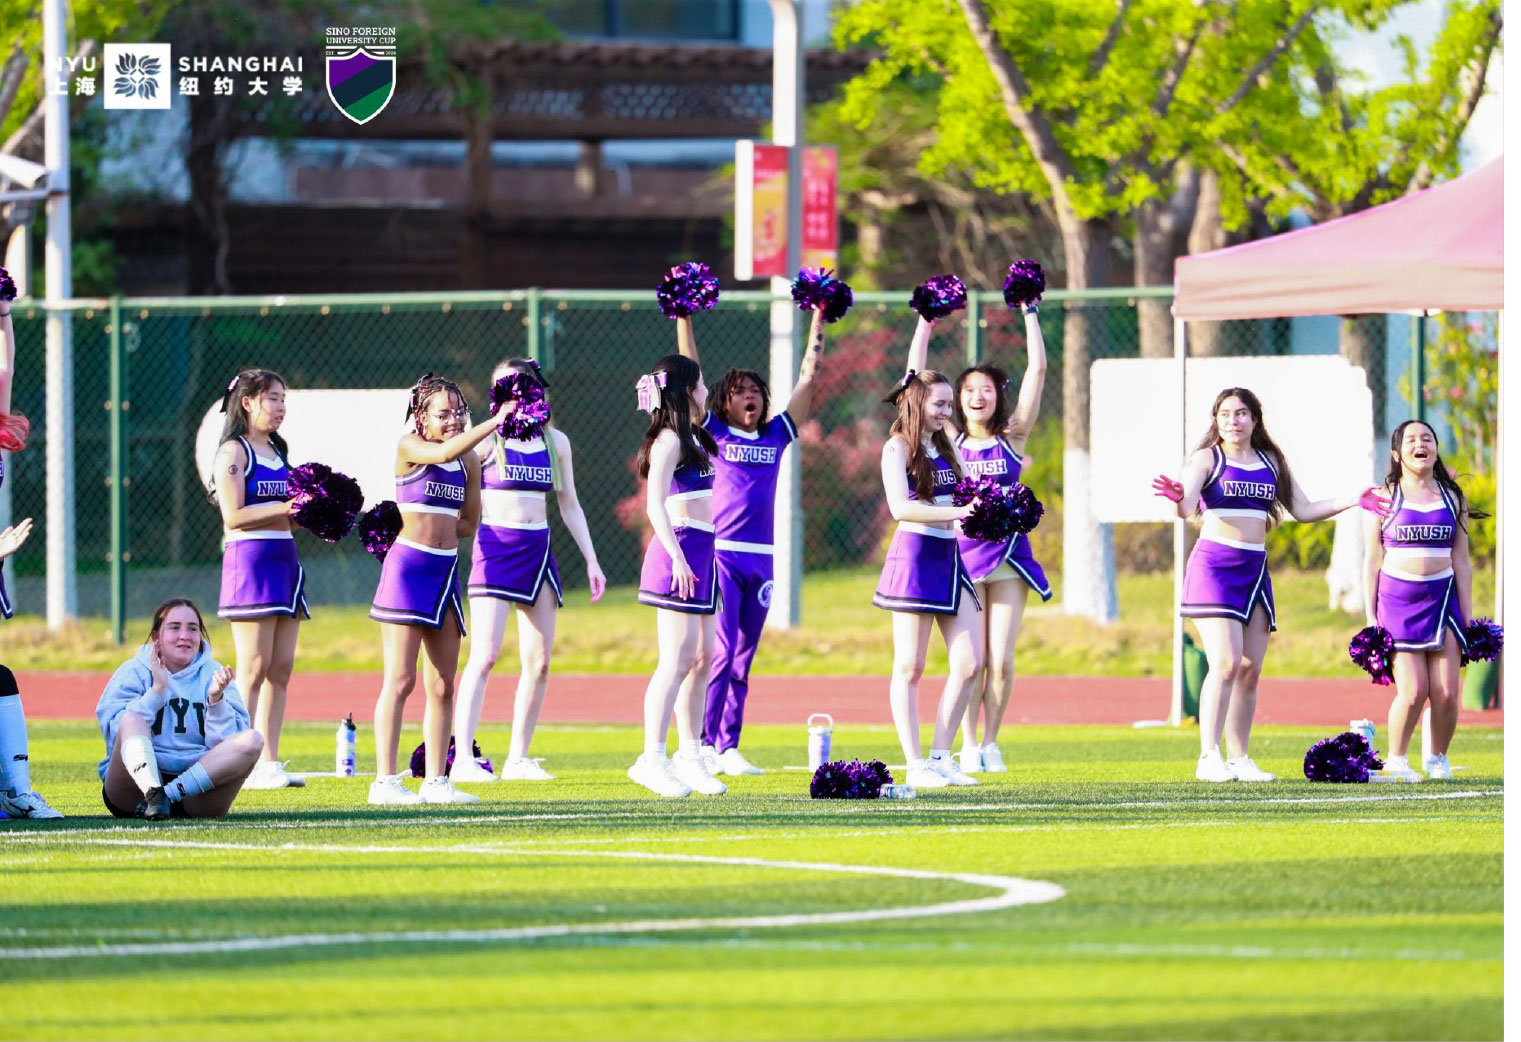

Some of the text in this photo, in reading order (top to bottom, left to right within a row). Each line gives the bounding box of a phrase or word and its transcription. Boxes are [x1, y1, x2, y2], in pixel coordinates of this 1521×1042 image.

[725, 443, 778, 464] NYUSH
[503, 464, 553, 484] NYUSH
[964, 458, 1009, 476] YUSH
[257, 480, 289, 497] NYU
[1223, 480, 1276, 500] NYUSH
[1396, 525, 1453, 541] NYUSH
